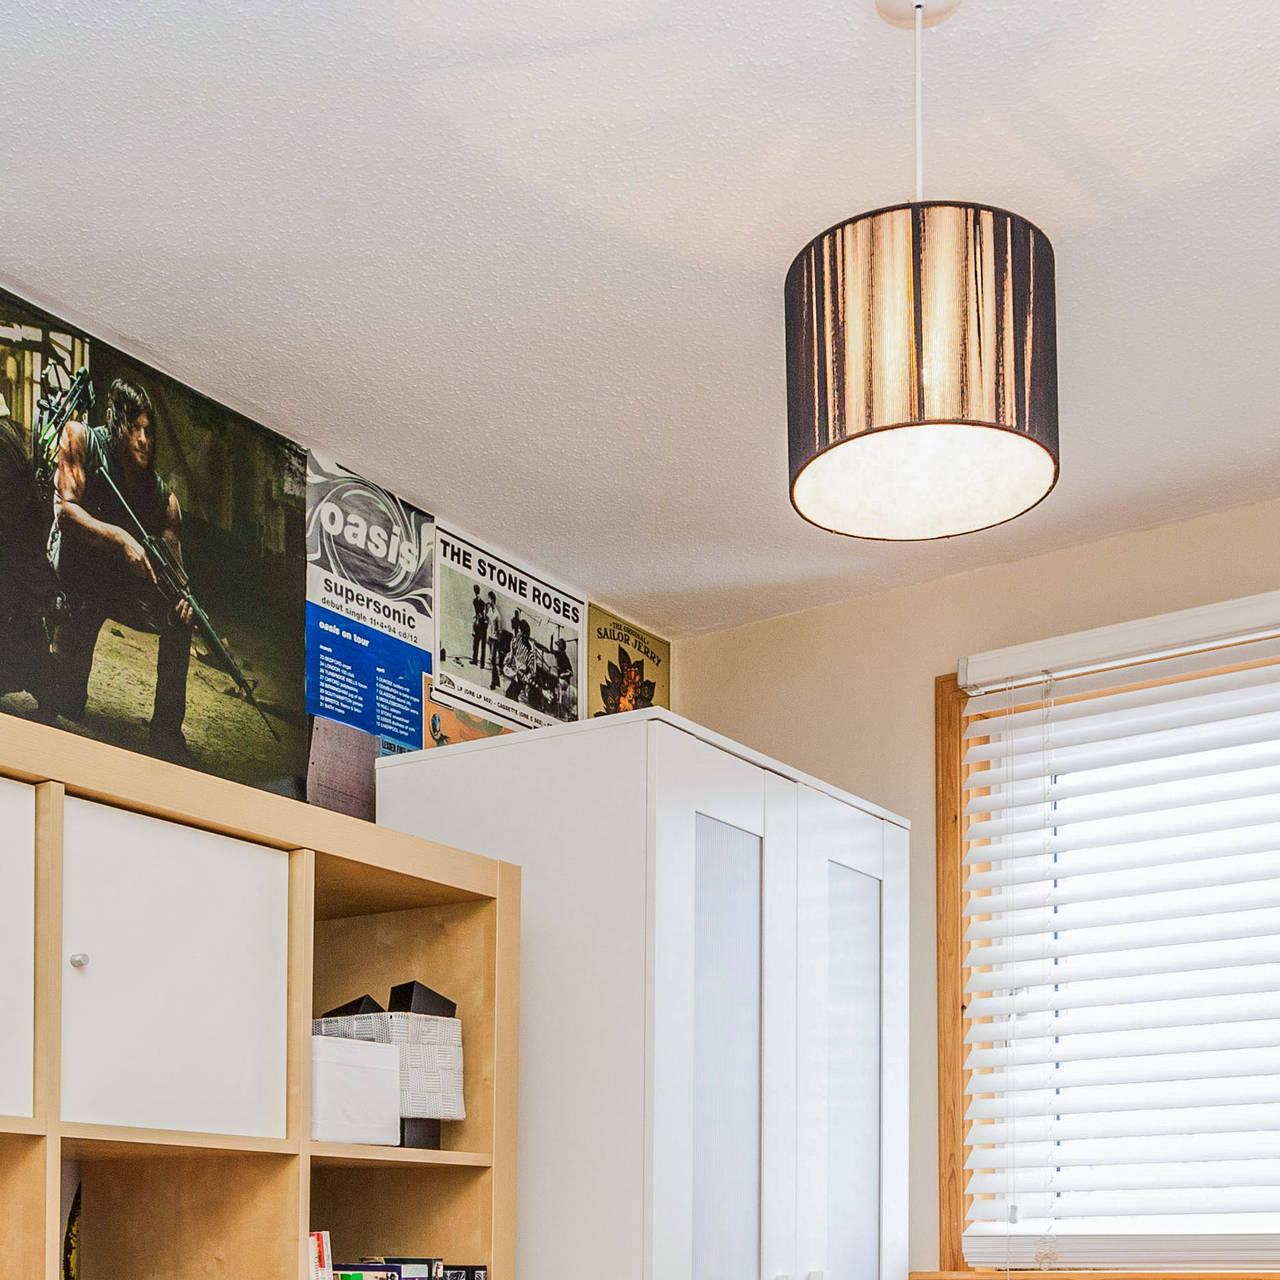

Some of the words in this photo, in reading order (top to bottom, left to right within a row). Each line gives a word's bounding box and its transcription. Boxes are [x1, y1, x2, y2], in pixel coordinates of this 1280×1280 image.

[319, 501, 419, 573] oasis
[323, 577, 417, 630] supersonic
[439, 537, 473, 570] THE
[477, 556, 528, 598] STONE
[531, 586, 580, 625] ROSES
[318, 620, 340, 635] oasis
[341, 630, 352, 640] on
[353, 633, 370, 647] tour
[321, 597, 343, 612] debut
[345, 606, 367, 622] single
[398, 630, 419, 644] cd/12
[596, 627, 631, 646] SAILOR
[631, 638, 662, 667] JERRY
